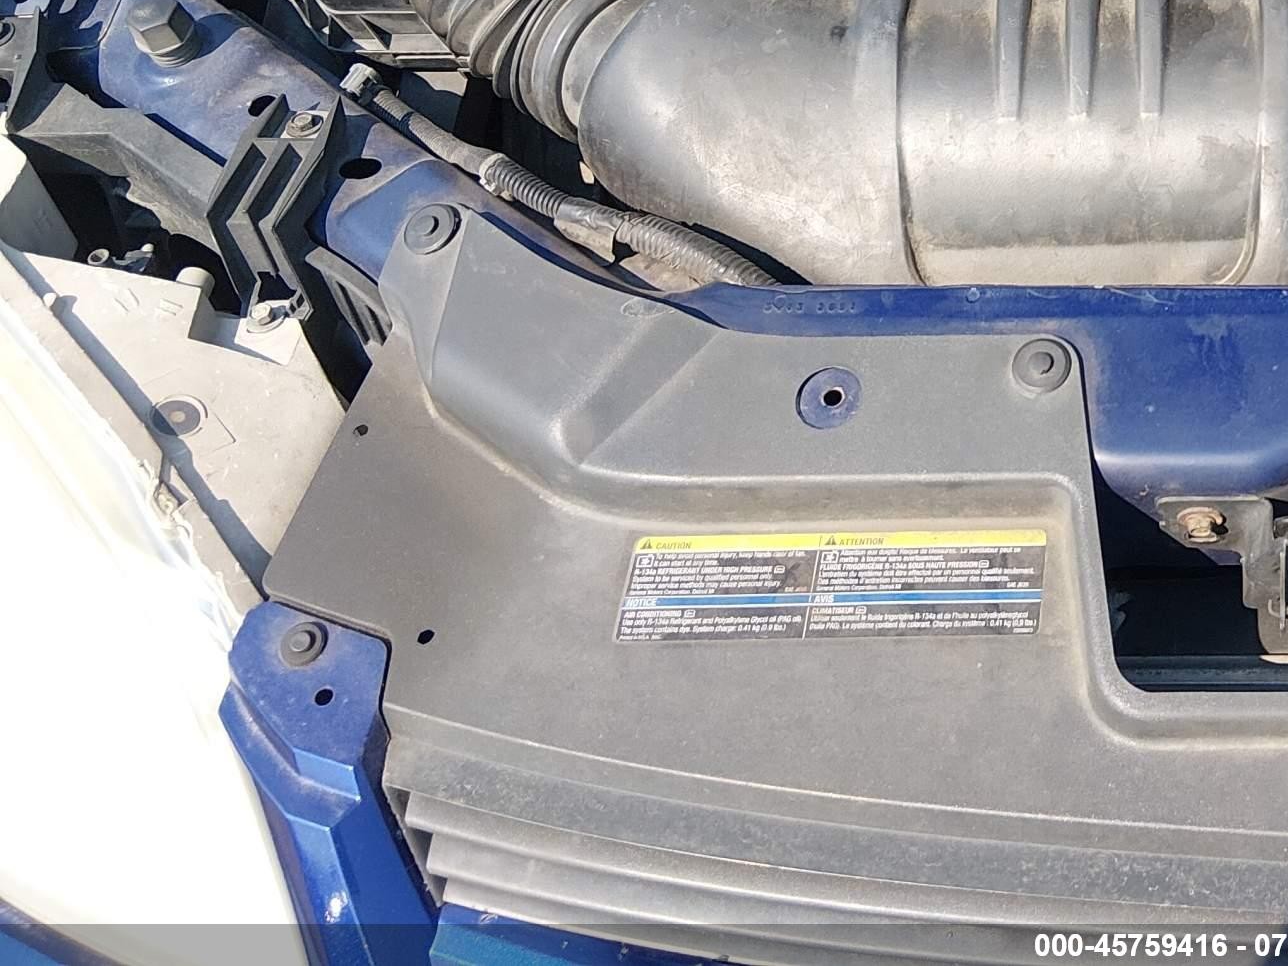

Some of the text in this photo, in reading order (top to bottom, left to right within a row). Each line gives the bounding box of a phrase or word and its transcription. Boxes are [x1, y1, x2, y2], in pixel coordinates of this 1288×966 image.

[656, 541, 692, 549] CAUTION
[839, 537, 884, 545] ATTENTION
[884, 561, 907, 569] R-134a
[947, 560, 978, 568] PRESSION
[657, 566, 699, 574] REFRIGERANT
[700, 566, 723, 574] UNDER
[740, 565, 773, 573] PRESSURE
[626, 597, 657, 607] NOTICE
[814, 594, 834, 602] AVIS
[624, 610, 636, 618] AIR
[812, 606, 854, 614] CLIMATISEUR
[750, 615, 768, 624] Glycol
